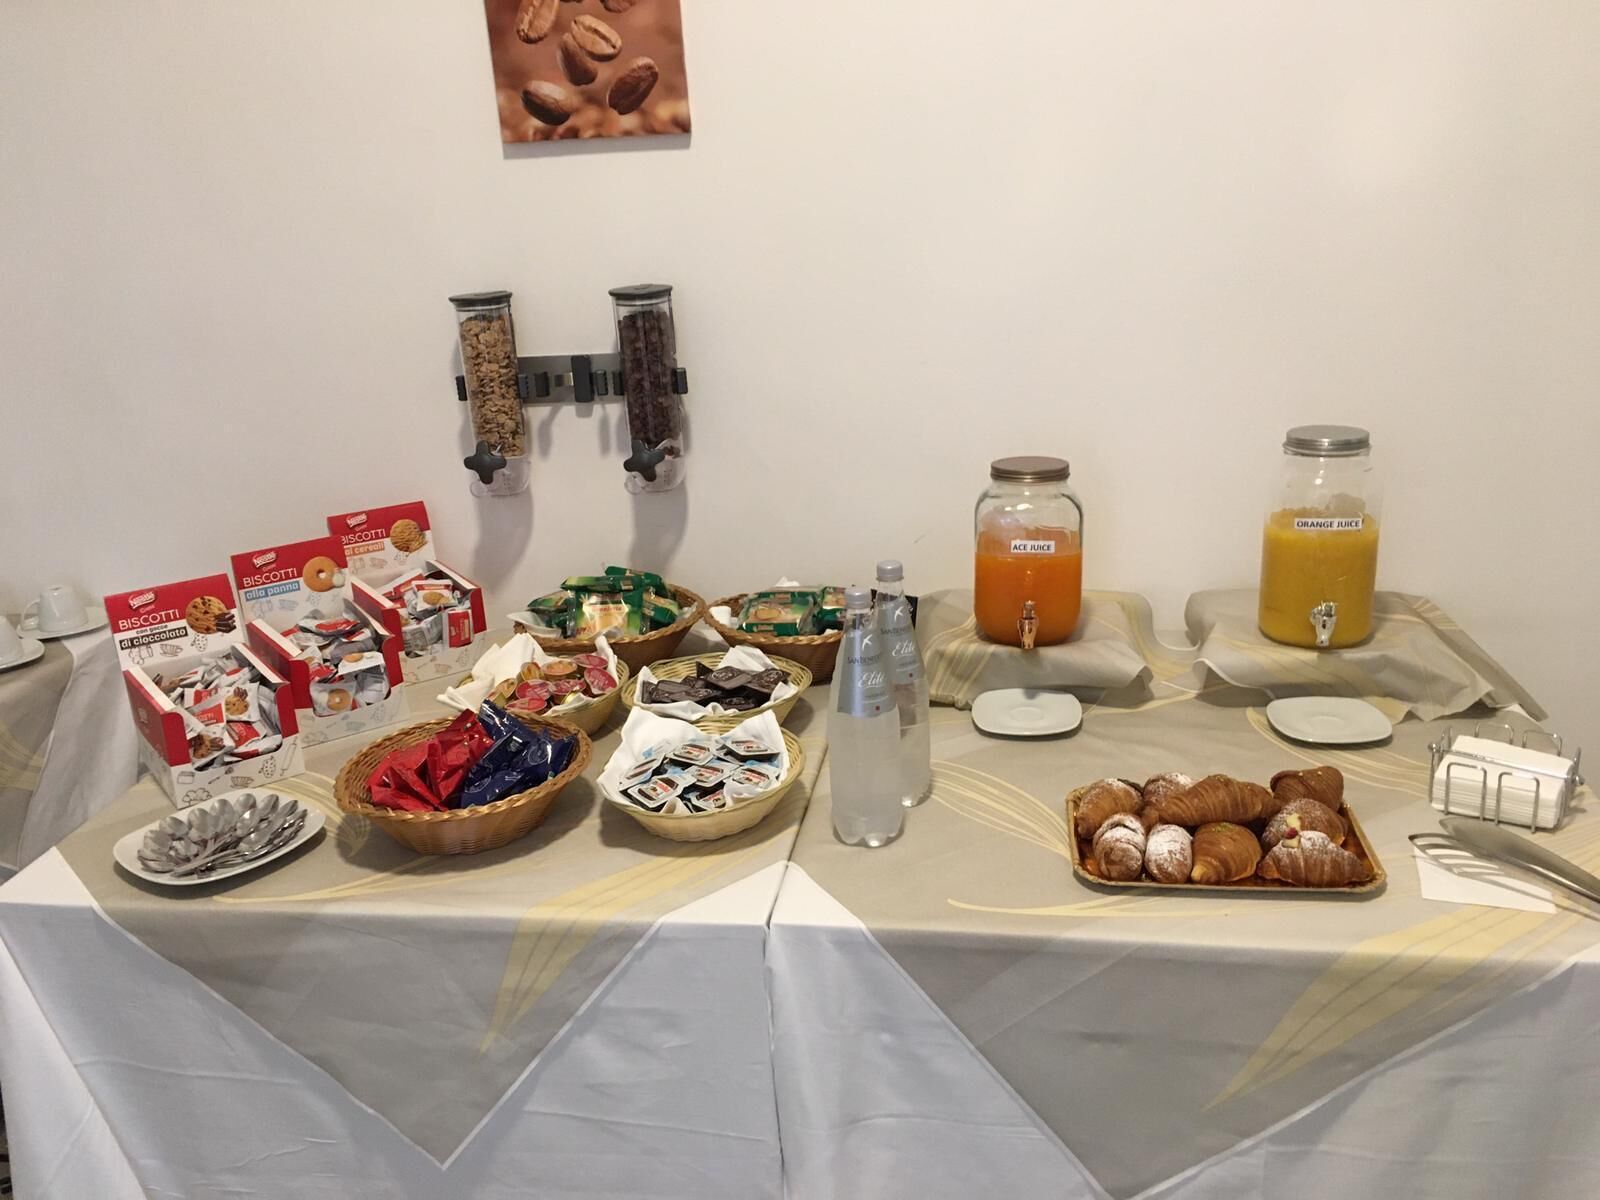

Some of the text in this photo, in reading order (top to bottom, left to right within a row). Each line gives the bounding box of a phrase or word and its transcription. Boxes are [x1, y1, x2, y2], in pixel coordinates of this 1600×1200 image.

[1296, 519, 1361, 529] ORANGE JUICE
[354, 541, 385, 554] cereali
[1012, 543, 1052, 551] ACE JUICE
[242, 567, 298, 588] BISCOTTI
[246, 582, 299, 600] alla panna
[118, 608, 181, 631] BISCOTTI
[121, 628, 187, 649] di cioccolato
[135, 627, 149, 635] con
